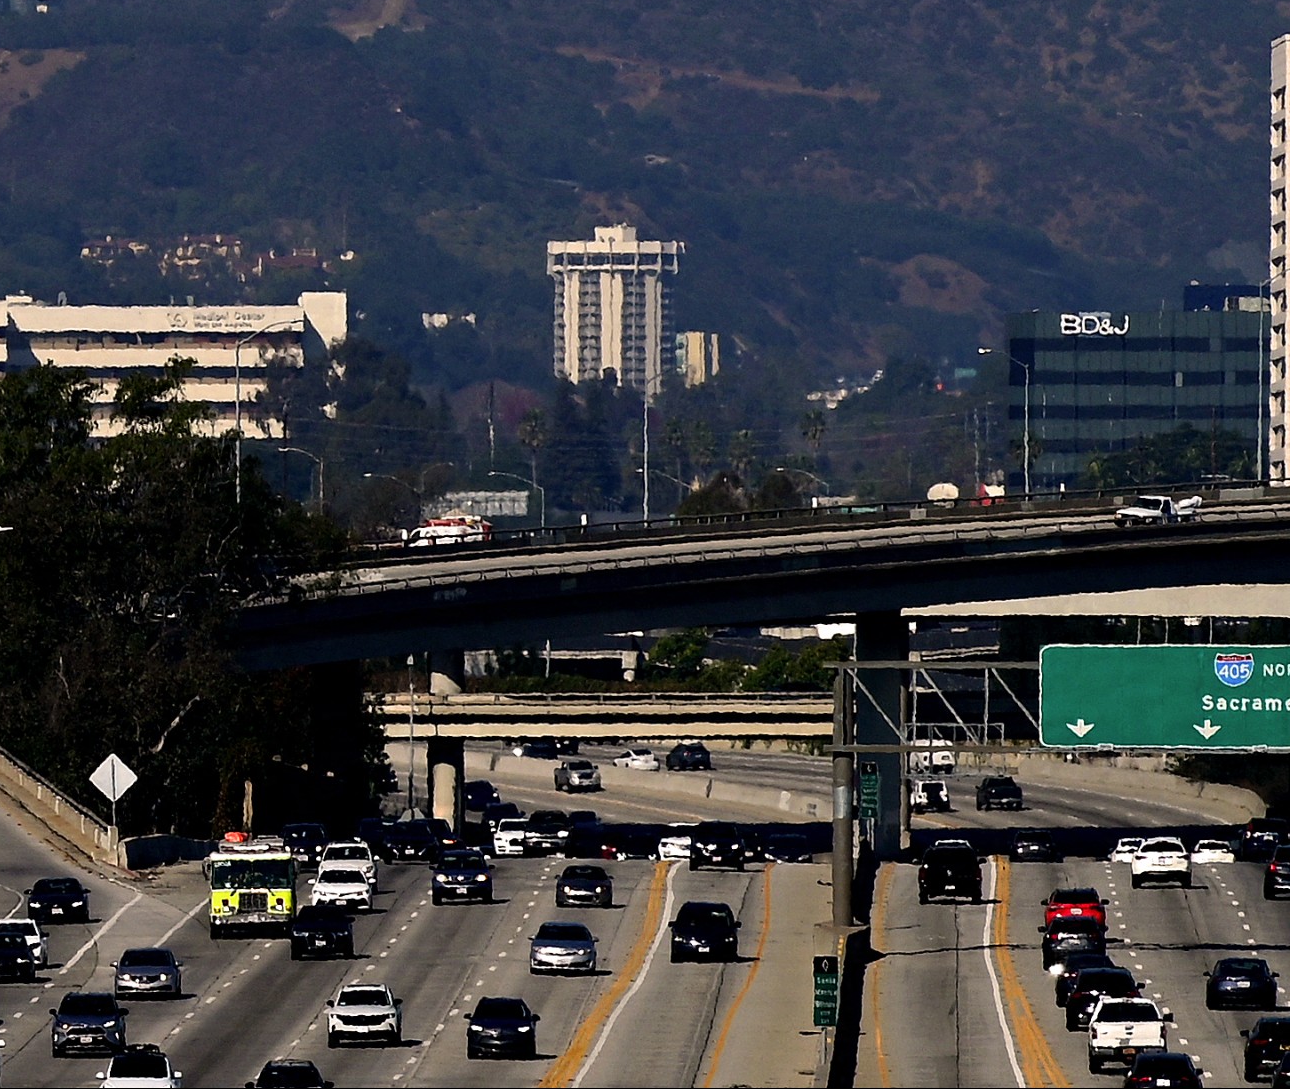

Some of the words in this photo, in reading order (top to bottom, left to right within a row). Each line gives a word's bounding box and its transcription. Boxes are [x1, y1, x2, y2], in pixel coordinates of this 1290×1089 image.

[1060, 314, 1129, 335] BD&J
[1218, 664, 1250, 679] 405
[1263, 663, 1290, 677] NO
